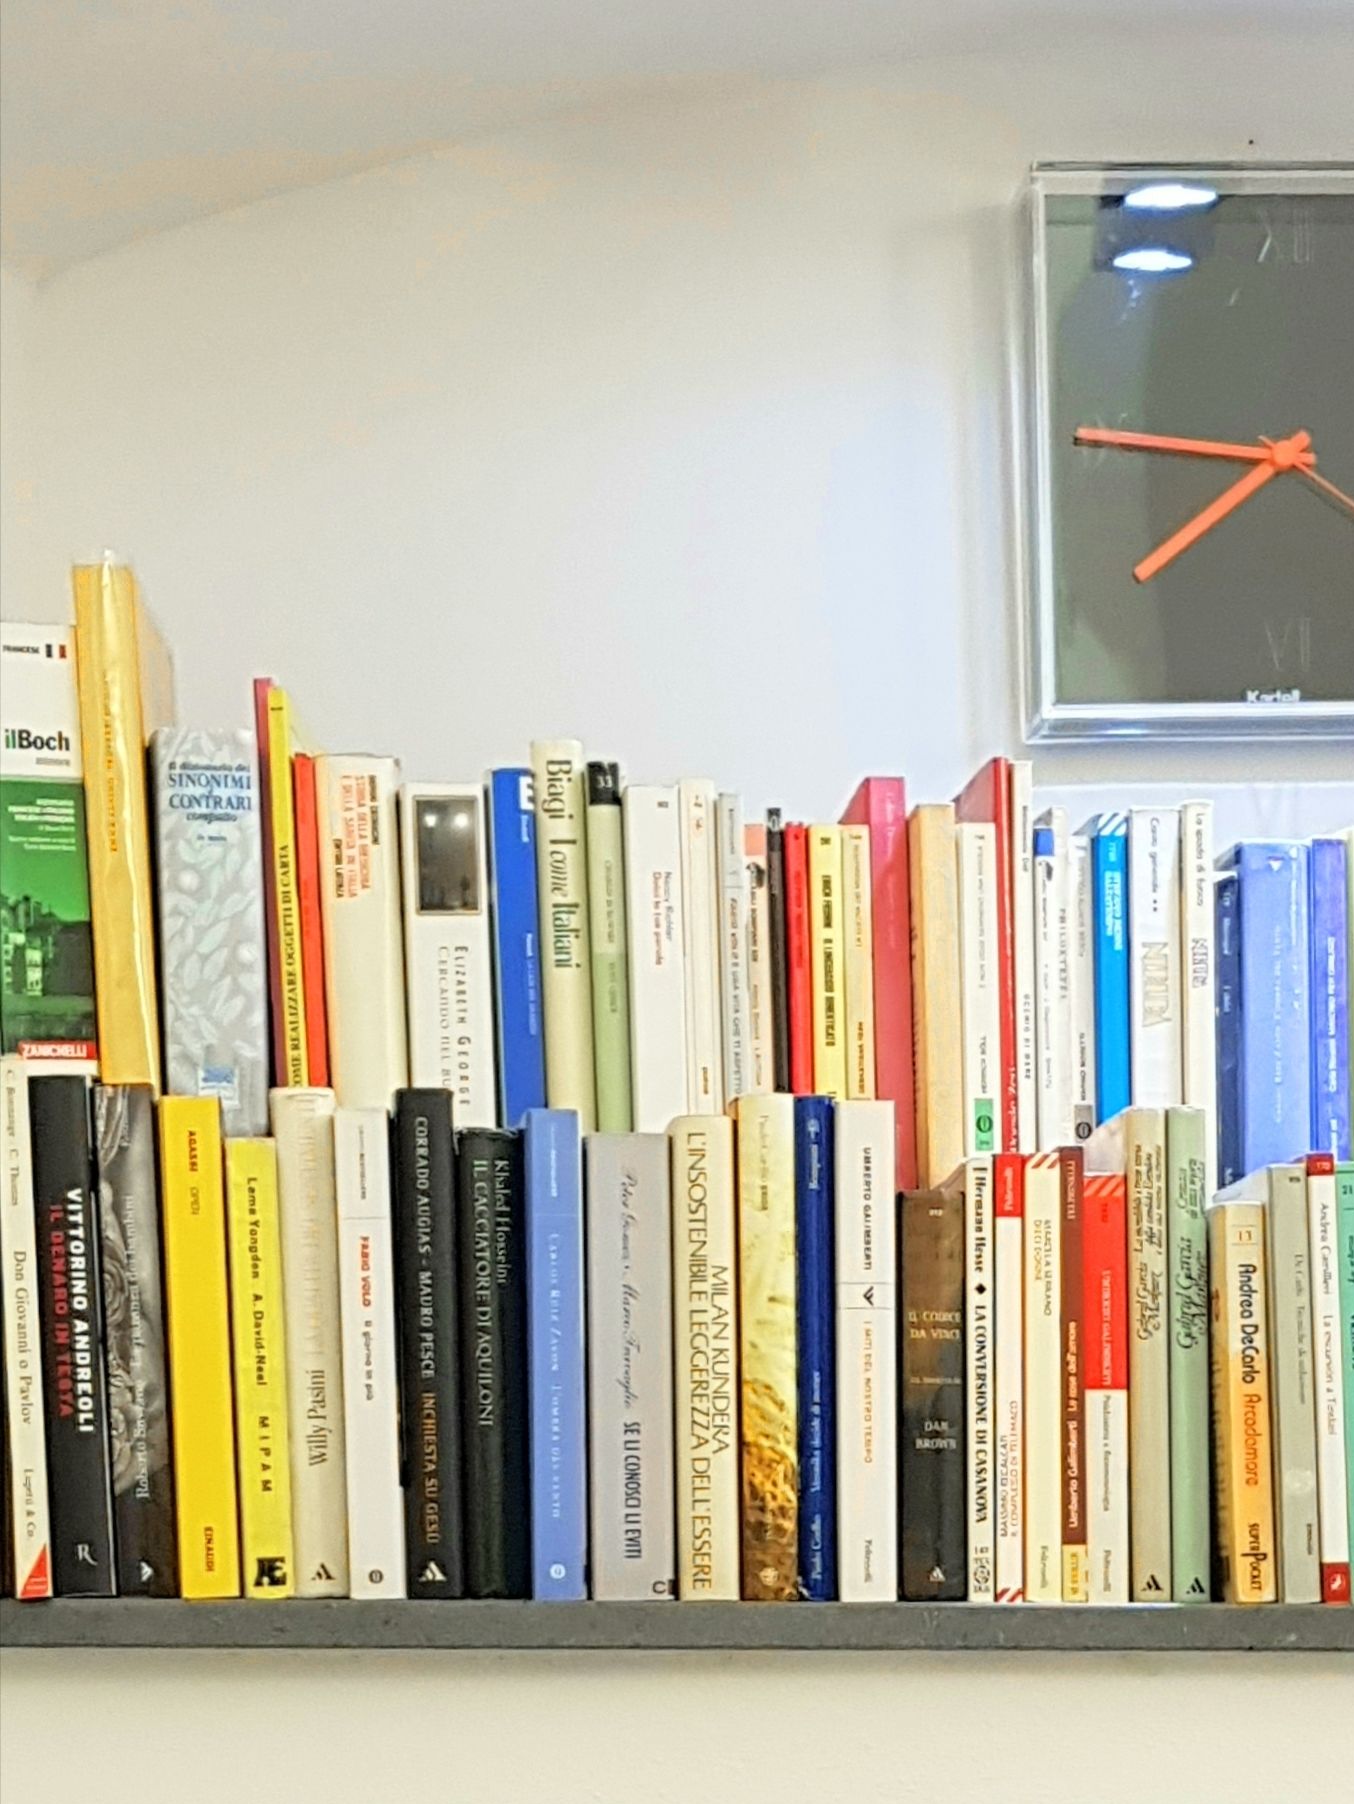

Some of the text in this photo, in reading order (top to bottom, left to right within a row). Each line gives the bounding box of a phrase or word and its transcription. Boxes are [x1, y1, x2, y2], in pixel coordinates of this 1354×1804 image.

[4, 729, 71, 753] ilBoch
[168, 772, 252, 791] SINONIMI
[542, 759, 574, 820] Biagi
[168, 793, 252, 812] CONTRARI
[278, 843, 302, 1052] REALIZZARE OGGETTI CARTA
[549, 850, 582, 968] come Italiani
[20, 1043, 88, 1059] ZANICHELLI
[454, 945, 471, 1106] ELIZABETH GEORGE
[123, 1194, 138, 1254] bambini
[188, 1185, 201, 1215] OPEN
[414, 1116, 437, 1327] CORRADO AUGIAS MAURO
[862, 1204, 873, 1271] GALIMBERTI
[12, 1250, 34, 1425] Don Giovanni Pavlov
[50, 1230, 74, 1417] DENARO TESTA
[66, 1187, 96, 1433] VITTORINO ANDREOLI
[473, 1181, 498, 1426] CACCIATORE DI AQUILONI
[1239, 1263, 1261, 1384] Andrea DeCarlo
[303, 1369, 328, 1420] Pasini
[686, 1131, 713, 1591] L'INSOSTENIBILE LEGGEREZZA DELL'ESSERE
[710, 1264, 732, 1455] MILAN KUNDERA
[133, 1440, 150, 1498] Roberto
[304, 1424, 333, 1466] Willy
[422, 1392, 441, 1498] INCHIESTA SU
[623, 1421, 643, 1559] SE EVITI
[974, 1429, 989, 1523] DI CASANOVA
